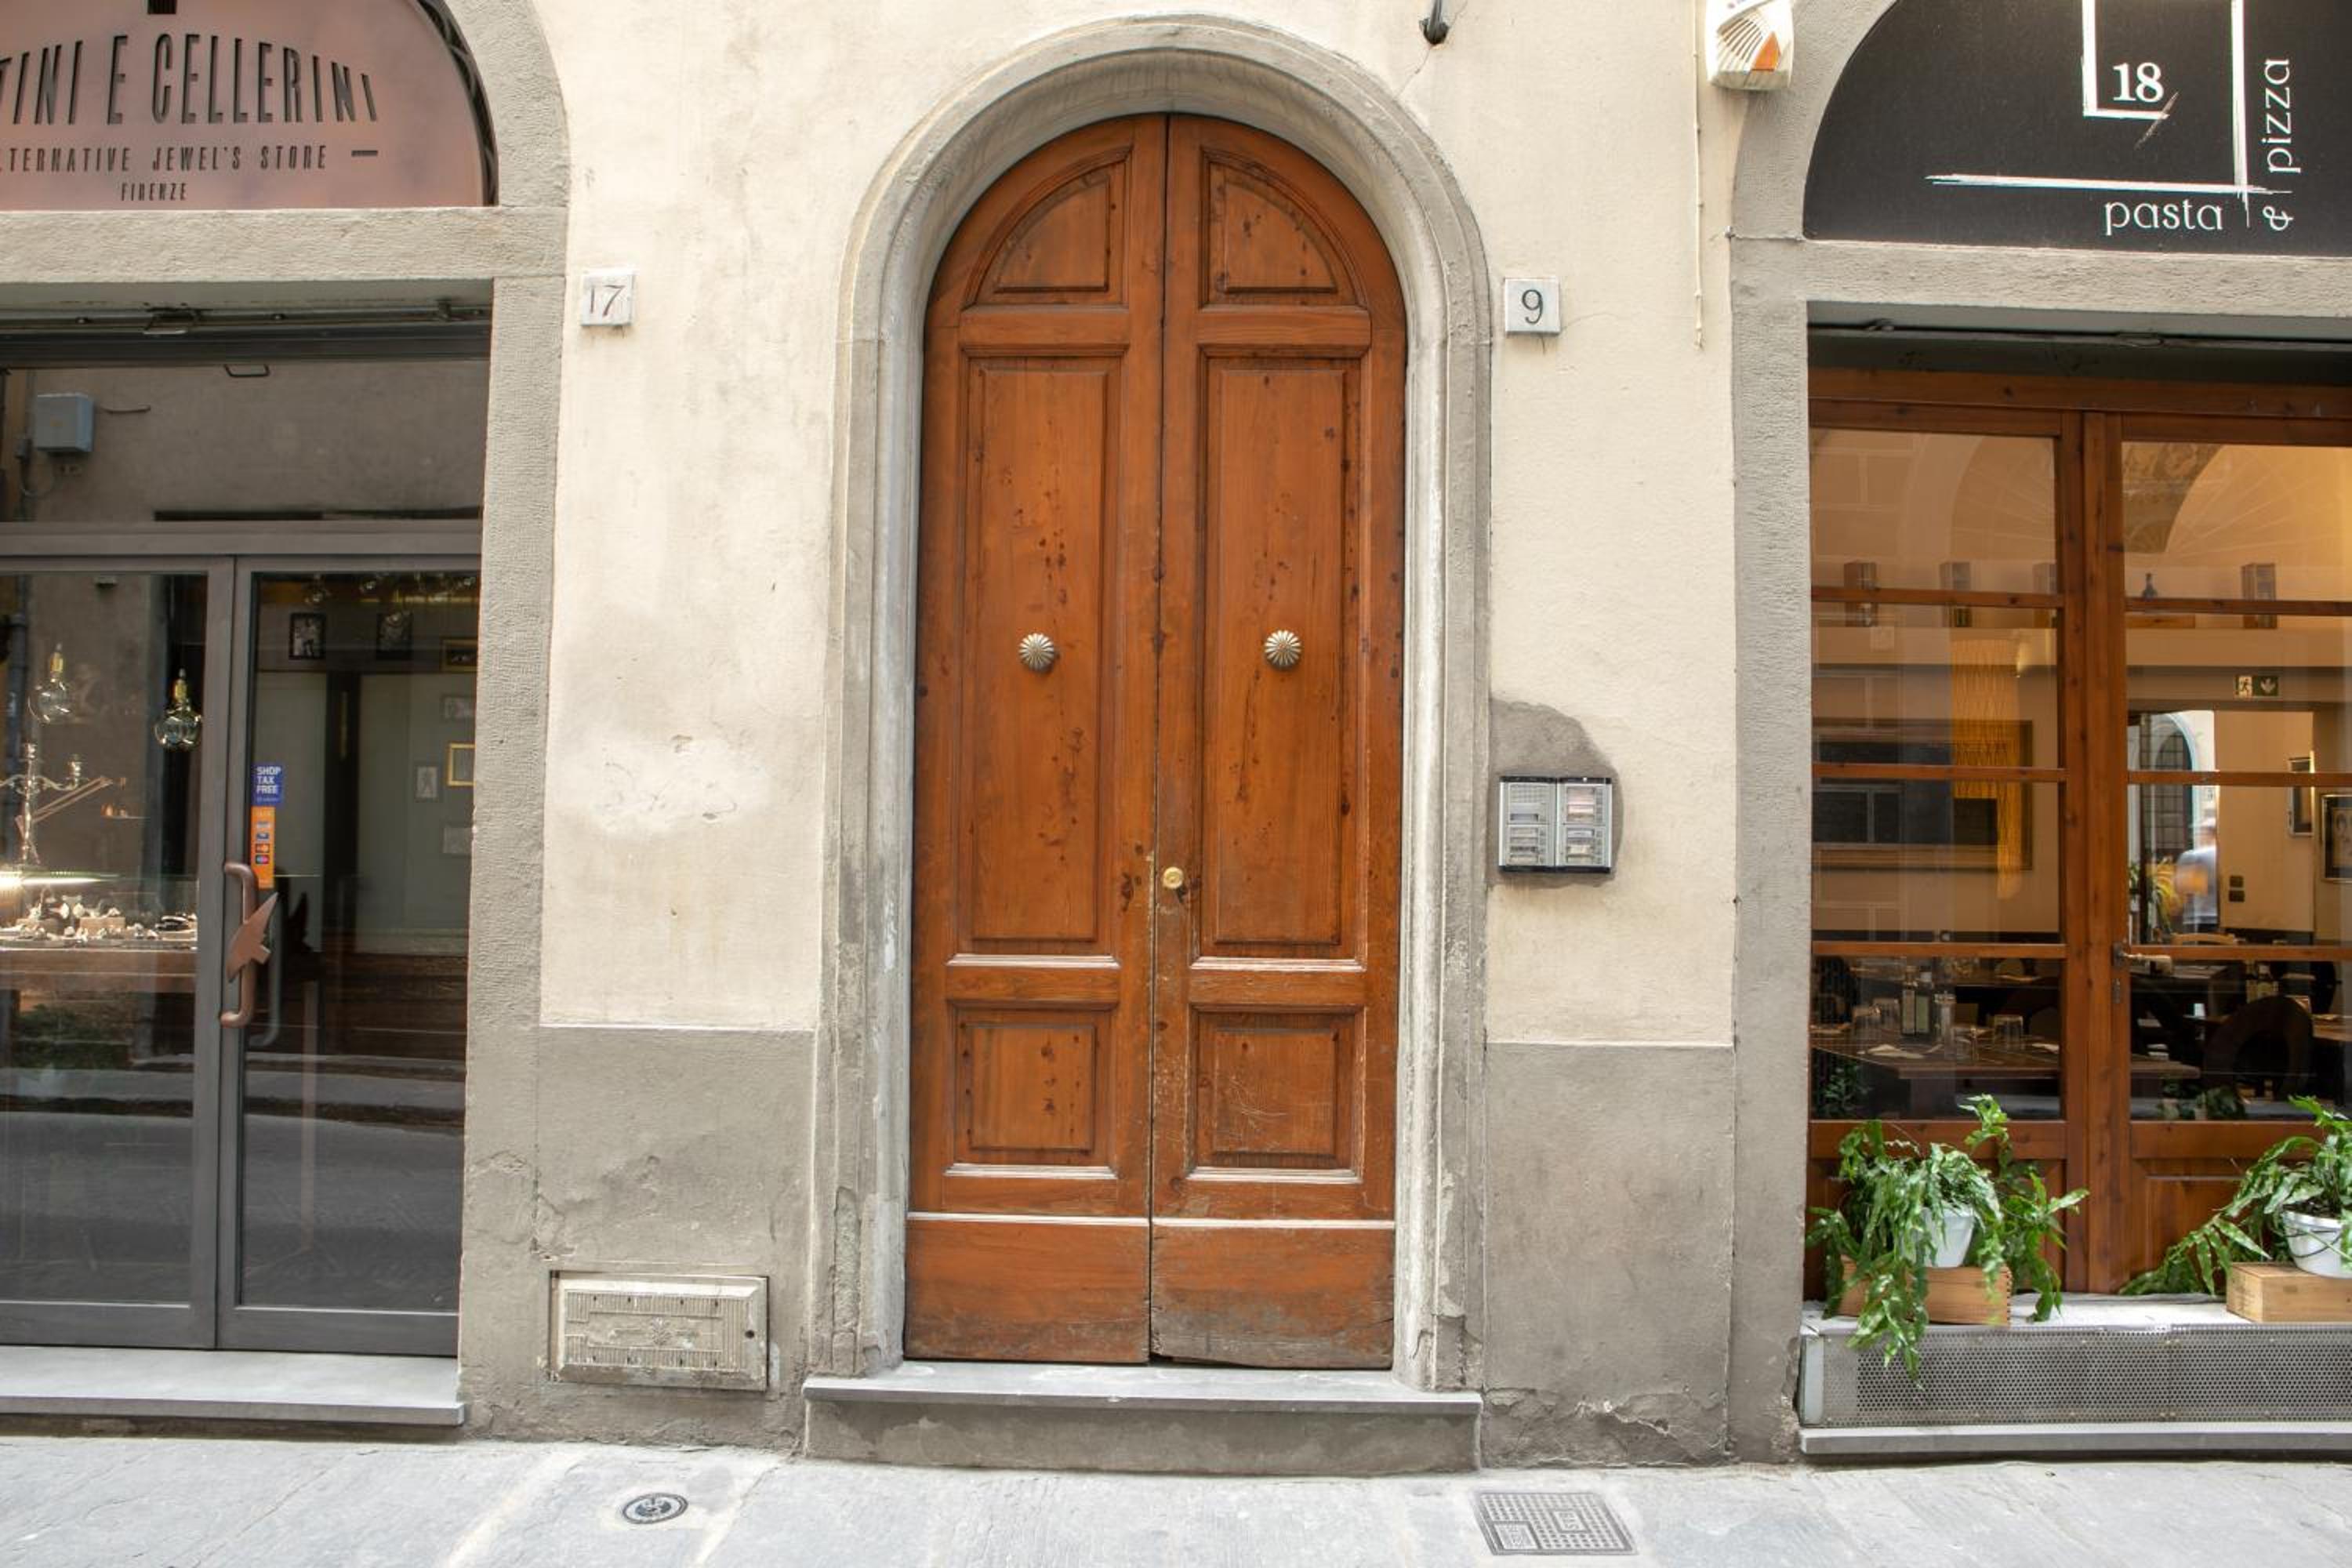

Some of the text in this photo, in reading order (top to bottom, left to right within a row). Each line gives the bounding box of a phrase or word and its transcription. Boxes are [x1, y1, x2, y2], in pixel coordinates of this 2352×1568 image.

[106, 34, 129, 125] E
[151, 33, 376, 124] CELLERINI
[2112, 62, 2164, 103] 18
[0, 144, 326, 172] TERNATIVE JEWEL'S STORE
[2261, 59, 2302, 230] & pizza
[121, 183, 187, 201] FIRENZE
[2104, 198, 2224, 236] pasta
[589, 285, 626, 318] 17
[1522, 289, 1544, 325] 9
[256, 766, 281, 775] SHOP
[256, 775, 276, 785] TAX
[256, 785, 279, 794] FREE
